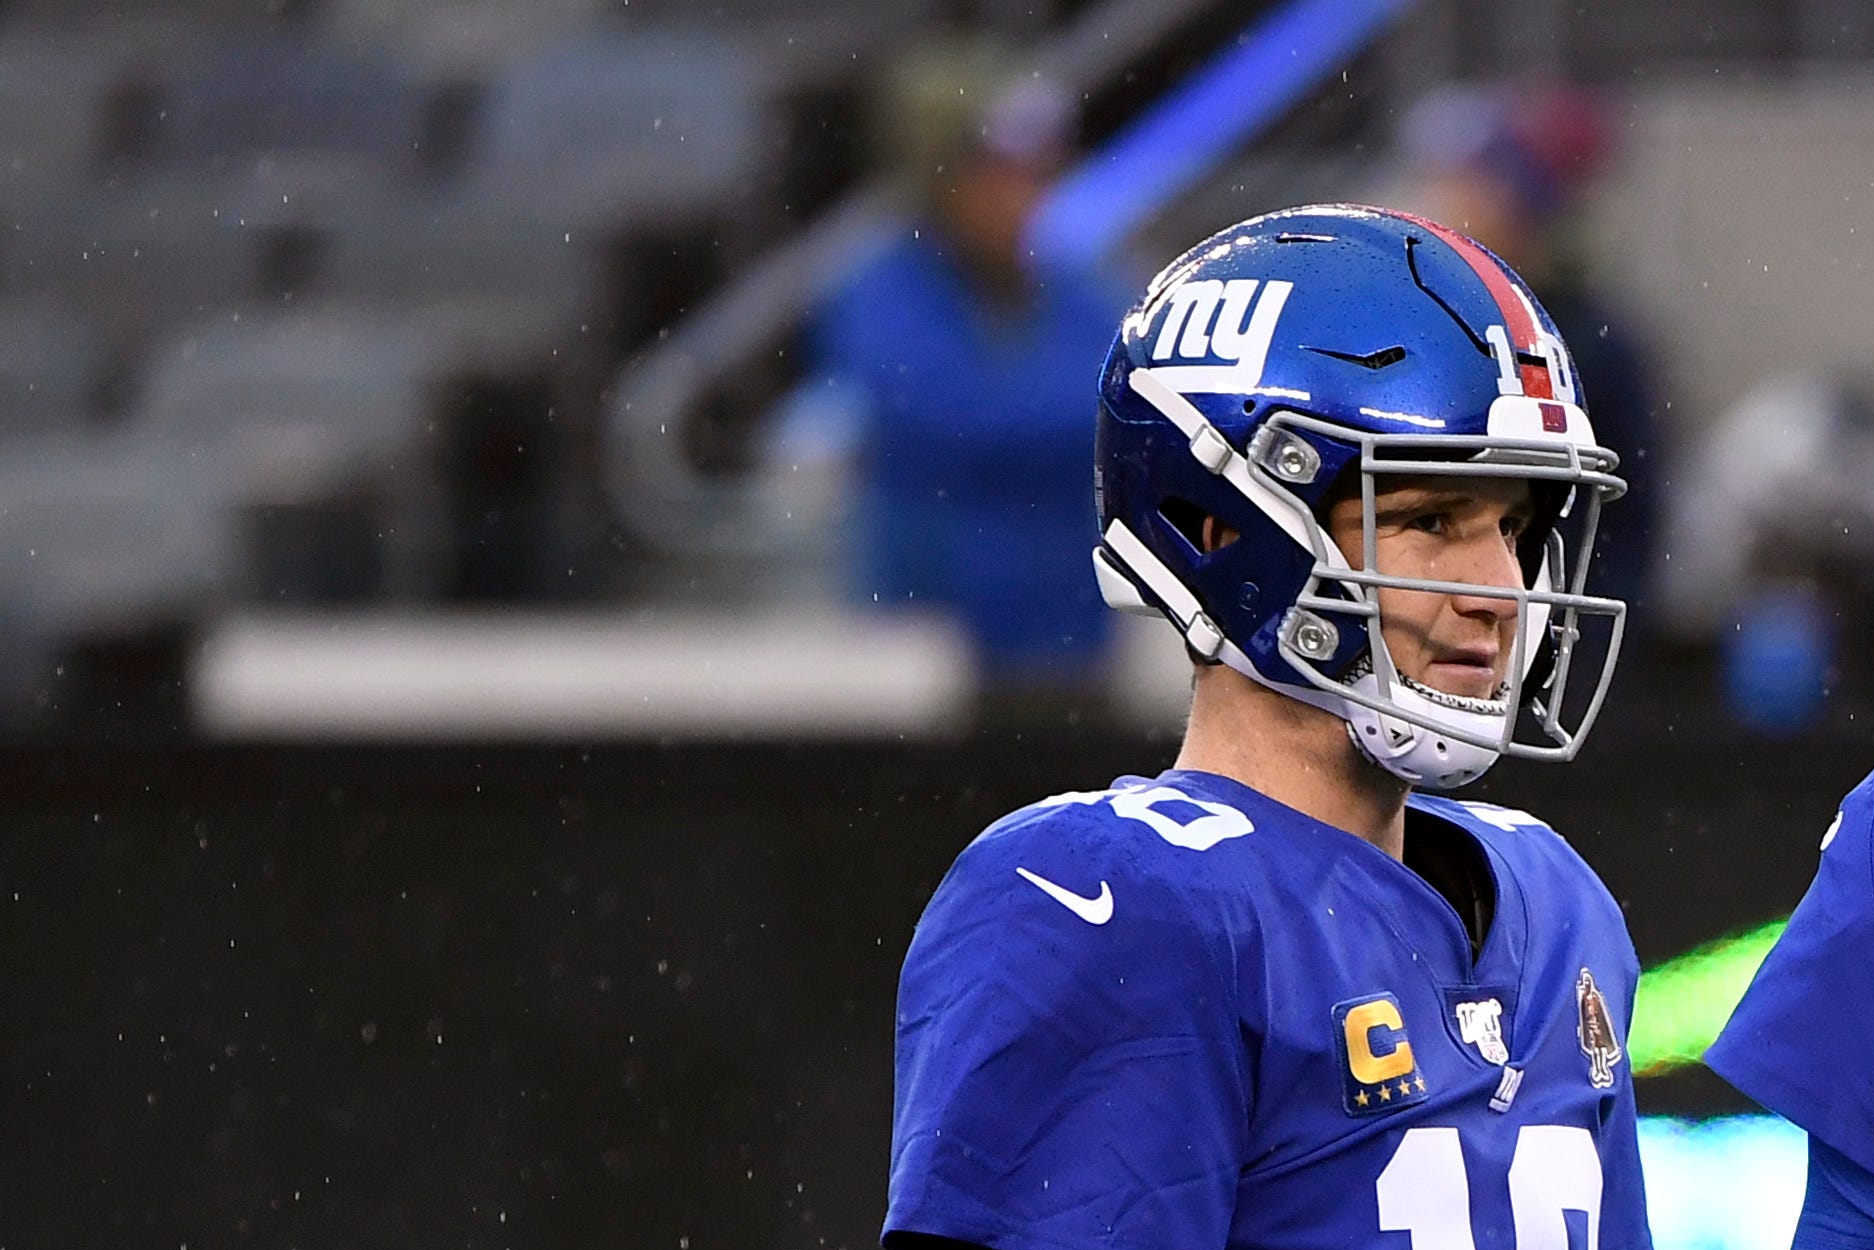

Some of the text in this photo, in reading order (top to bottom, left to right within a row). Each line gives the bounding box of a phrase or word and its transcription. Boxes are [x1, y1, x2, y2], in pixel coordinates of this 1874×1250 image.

[1150, 279, 1294, 394] ny
[1485, 325, 1576, 404] 10
[1344, 999, 1415, 1085] C
